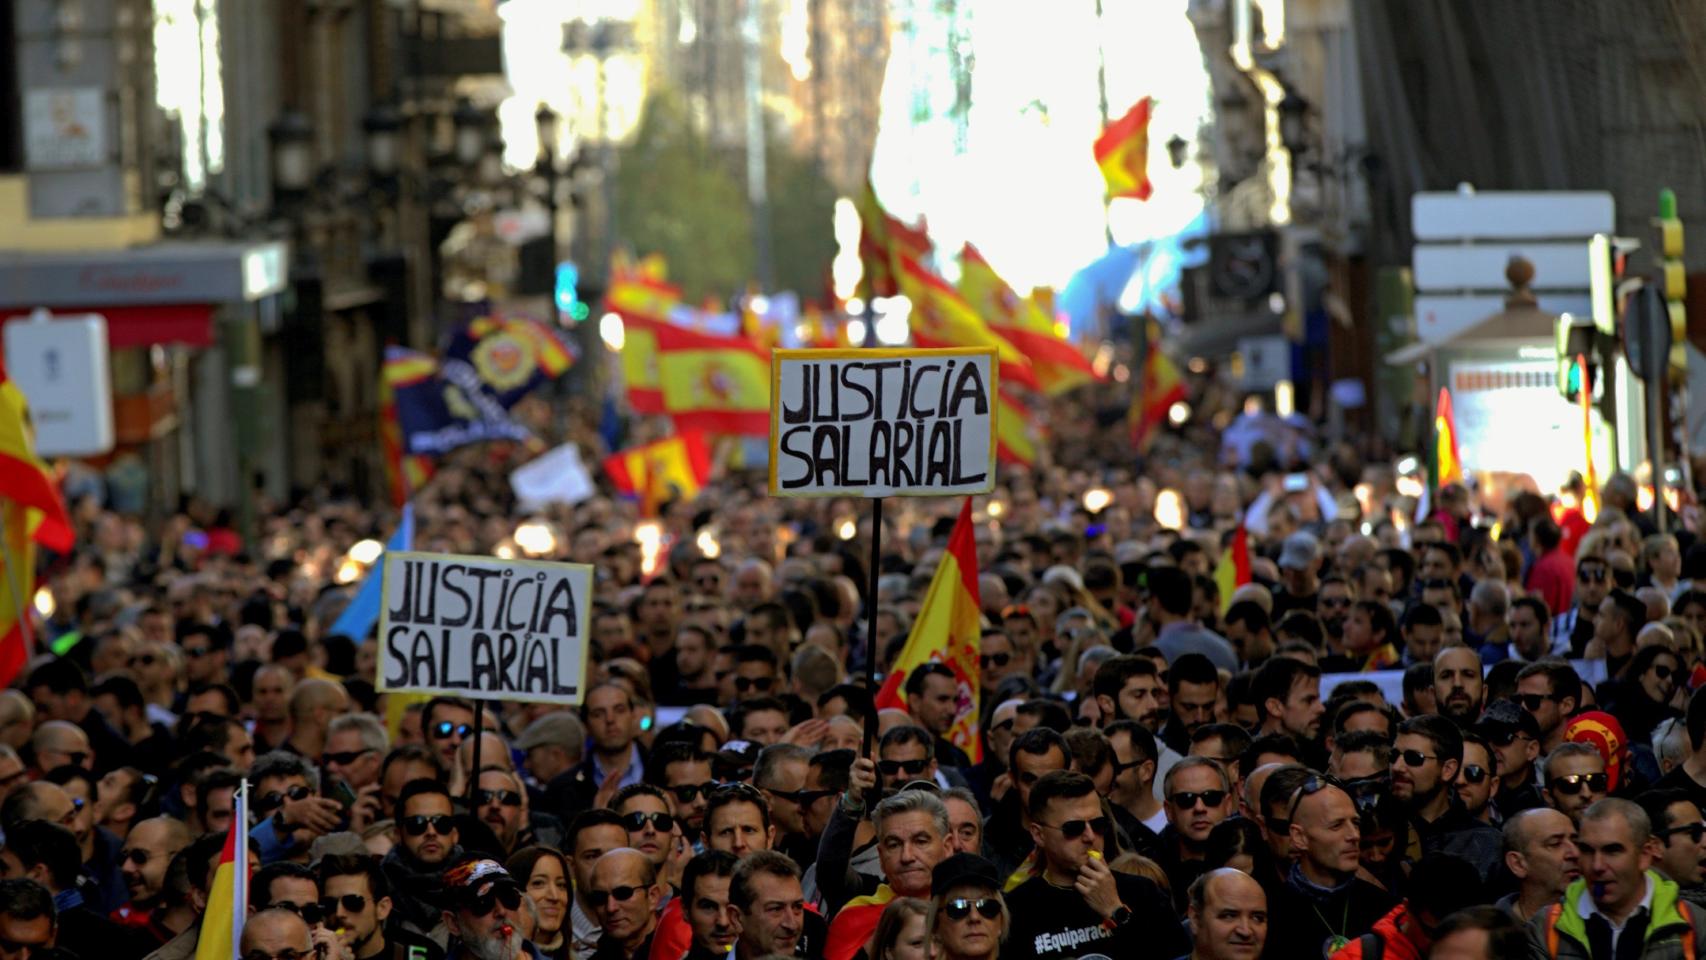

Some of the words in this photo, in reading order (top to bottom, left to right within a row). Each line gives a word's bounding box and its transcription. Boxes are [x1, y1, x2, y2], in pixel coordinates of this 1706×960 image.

[783, 359, 988, 424] JUSTICIA
[781, 418, 987, 488] SALARIAL
[389, 561, 577, 637] JUSTICIA
[386, 625, 577, 695] SALARIAL
